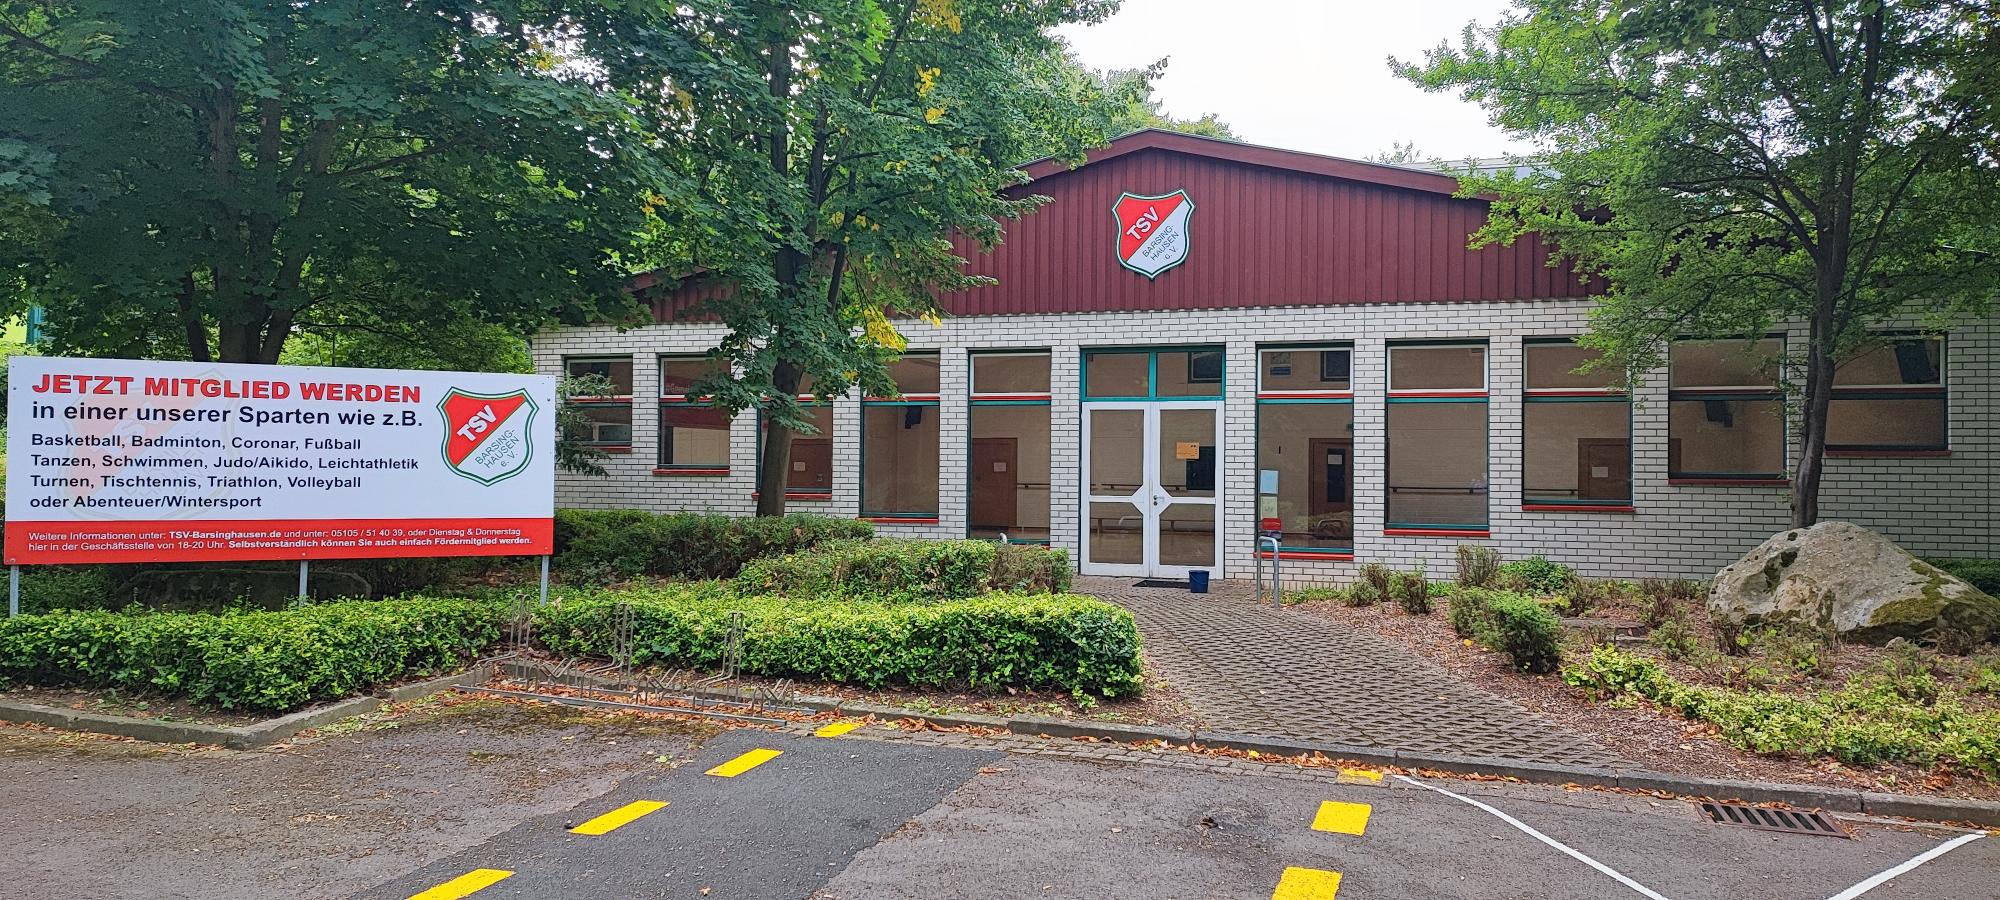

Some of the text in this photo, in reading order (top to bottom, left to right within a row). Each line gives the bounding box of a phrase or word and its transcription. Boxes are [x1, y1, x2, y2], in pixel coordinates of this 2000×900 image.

[1126, 205, 1160, 240] TSV
[1150, 231, 1179, 261] HAUSEN
[32, 374, 420, 403] JETZT MITGLIED WERDEN
[32, 401, 422, 427] in einer unserer Sparten wie z.B.
[456, 404, 497, 442] TSV
[32, 434, 360, 451] Basketball, Badminton, Coronar, Fußball
[475, 429, 515, 465] BARSING-
[484, 435, 520, 469] HAUSEN
[31, 454, 419, 470] Tanzen, Schwimmen, Judo/Aikido, Leichtathletik
[30, 475, 361, 490] Turnen, Tischtennis, Triathlon, Volleyball
[30, 496, 262, 509] oder Abenteuer/Wintersport
[28, 543, 48, 551] hier
[50, 543, 59, 551] in
[62, 543, 78, 551] der
[80, 542, 154, 550] Geschäftsstelle
[178, 542, 204, 550] 18-20
[228, 540, 319, 549] Selbstverständlich
[320, 539, 356, 548] können
[358, 539, 373, 547] Sie
[374, 538, 397, 546] auch
[400, 538, 432, 546] einfach
[434, 537, 498, 548] Fördermitglied
[70, 532, 136, 540] Informationen
[169, 530, 282, 540] TSV-Barsinghausen.de
[360, 529, 364, 537] /
[366, 529, 376, 537] 51
[379, 529, 390, 537] 40
[428, 528, 465, 537] Dienstag
[466, 528, 474, 536] &
[475, 528, 520, 536] Donnerstag
